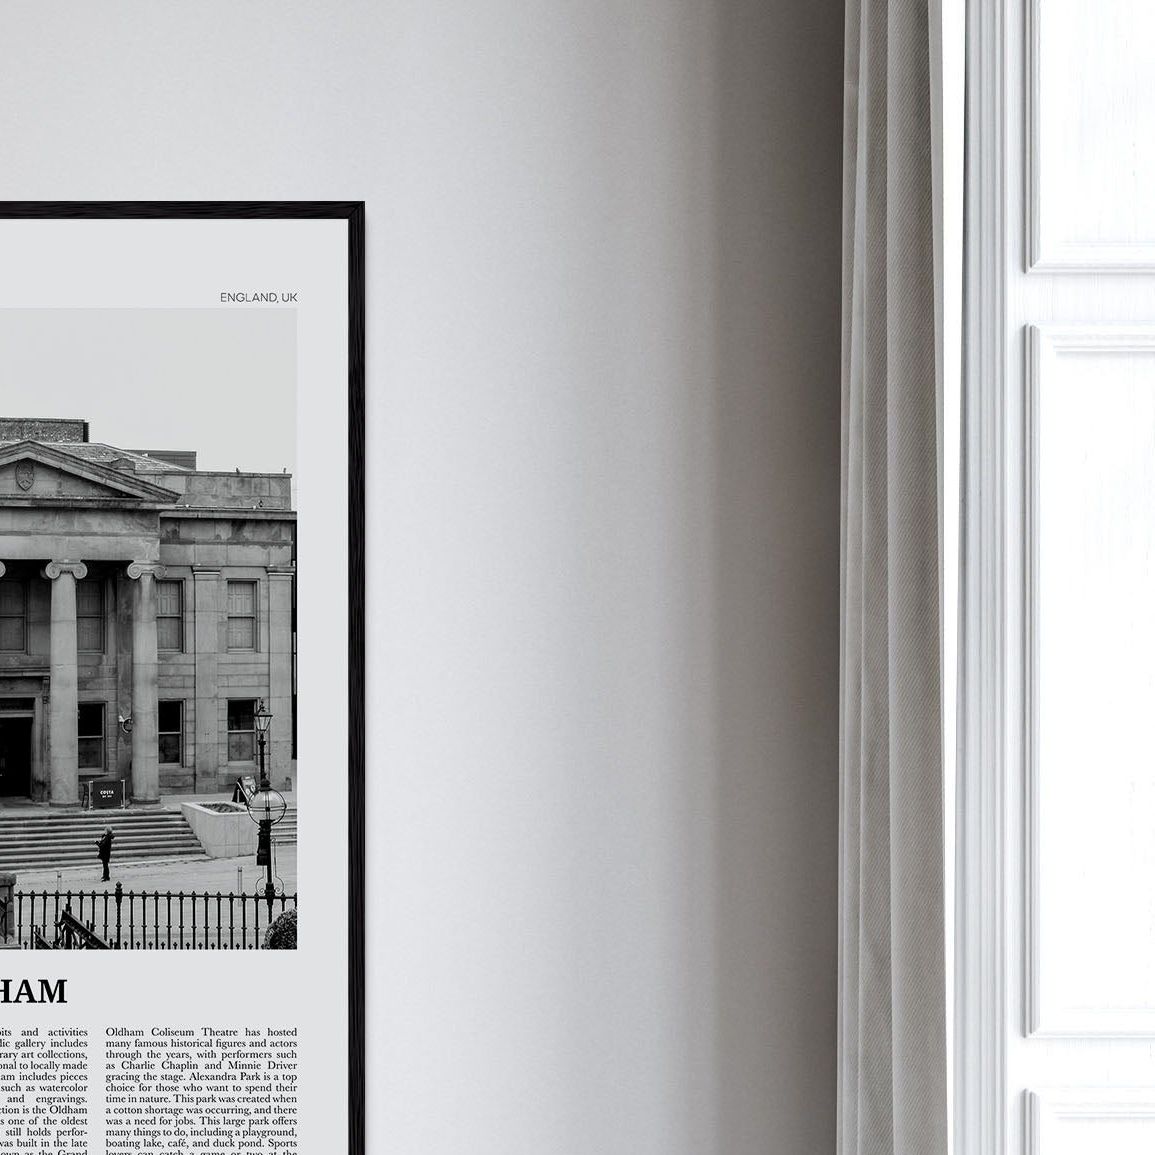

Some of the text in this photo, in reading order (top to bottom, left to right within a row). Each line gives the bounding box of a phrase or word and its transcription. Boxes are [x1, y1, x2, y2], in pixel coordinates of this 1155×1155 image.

[220, 292, 298, 303] ENGLAND, UK
[20, 1028, 39, 1036] and
[47, 1028, 88, 1036] activities
[105, 1028, 298, 1036] Oldham Coliseum Theatre has hosted
[14, 1039, 47, 1050] gallery
[50, 1039, 88, 1047] includes
[105, 1042, 132, 1050] many
[134, 1039, 168, 1047] famous
[170, 1039, 213, 1047] historical
[215, 1039, 247, 1050] figures
[248, 1039, 267, 1047] and
[36, 1050, 88, 1060] collections,
[105, 1050, 297, 1061] through the years, with performers such
[19, 1062, 29, 1070] to
[30, 1061, 61, 1072] locally
[62, 1061, 88, 1070] made
[121, 1061, 156, 1070] Charlie
[161, 1061, 199, 1072] Chaplin
[204, 1061, 222, 1070] and
[228, 1061, 262, 1070] Minnie
[267, 1061, 298, 1070] Driver
[0, 1083, 22, 1092] such
[39, 1083, 89, 1092] watercolor
[105, 1083, 298, 1094] choice for those who want to spend their
[6, 1094, 25, 1103] and
[35, 1095, 88, 1105] engravings.
[134, 1117, 157, 1125] need
[159, 1117, 173, 1125] for
[173, 1117, 196, 1127] jobs.
[198, 1117, 221, 1125] This
[223, 1117, 246, 1127] large
[248, 1117, 270, 1127] park
[271, 1117, 298, 1125] offers
[5, 1128, 22, 1136] still
[26, 1128, 52, 1136] holds
[56, 1128, 88, 1138] perfor-
[105, 1139, 298, 1150] boating lake, café, and duck pond. Sports
